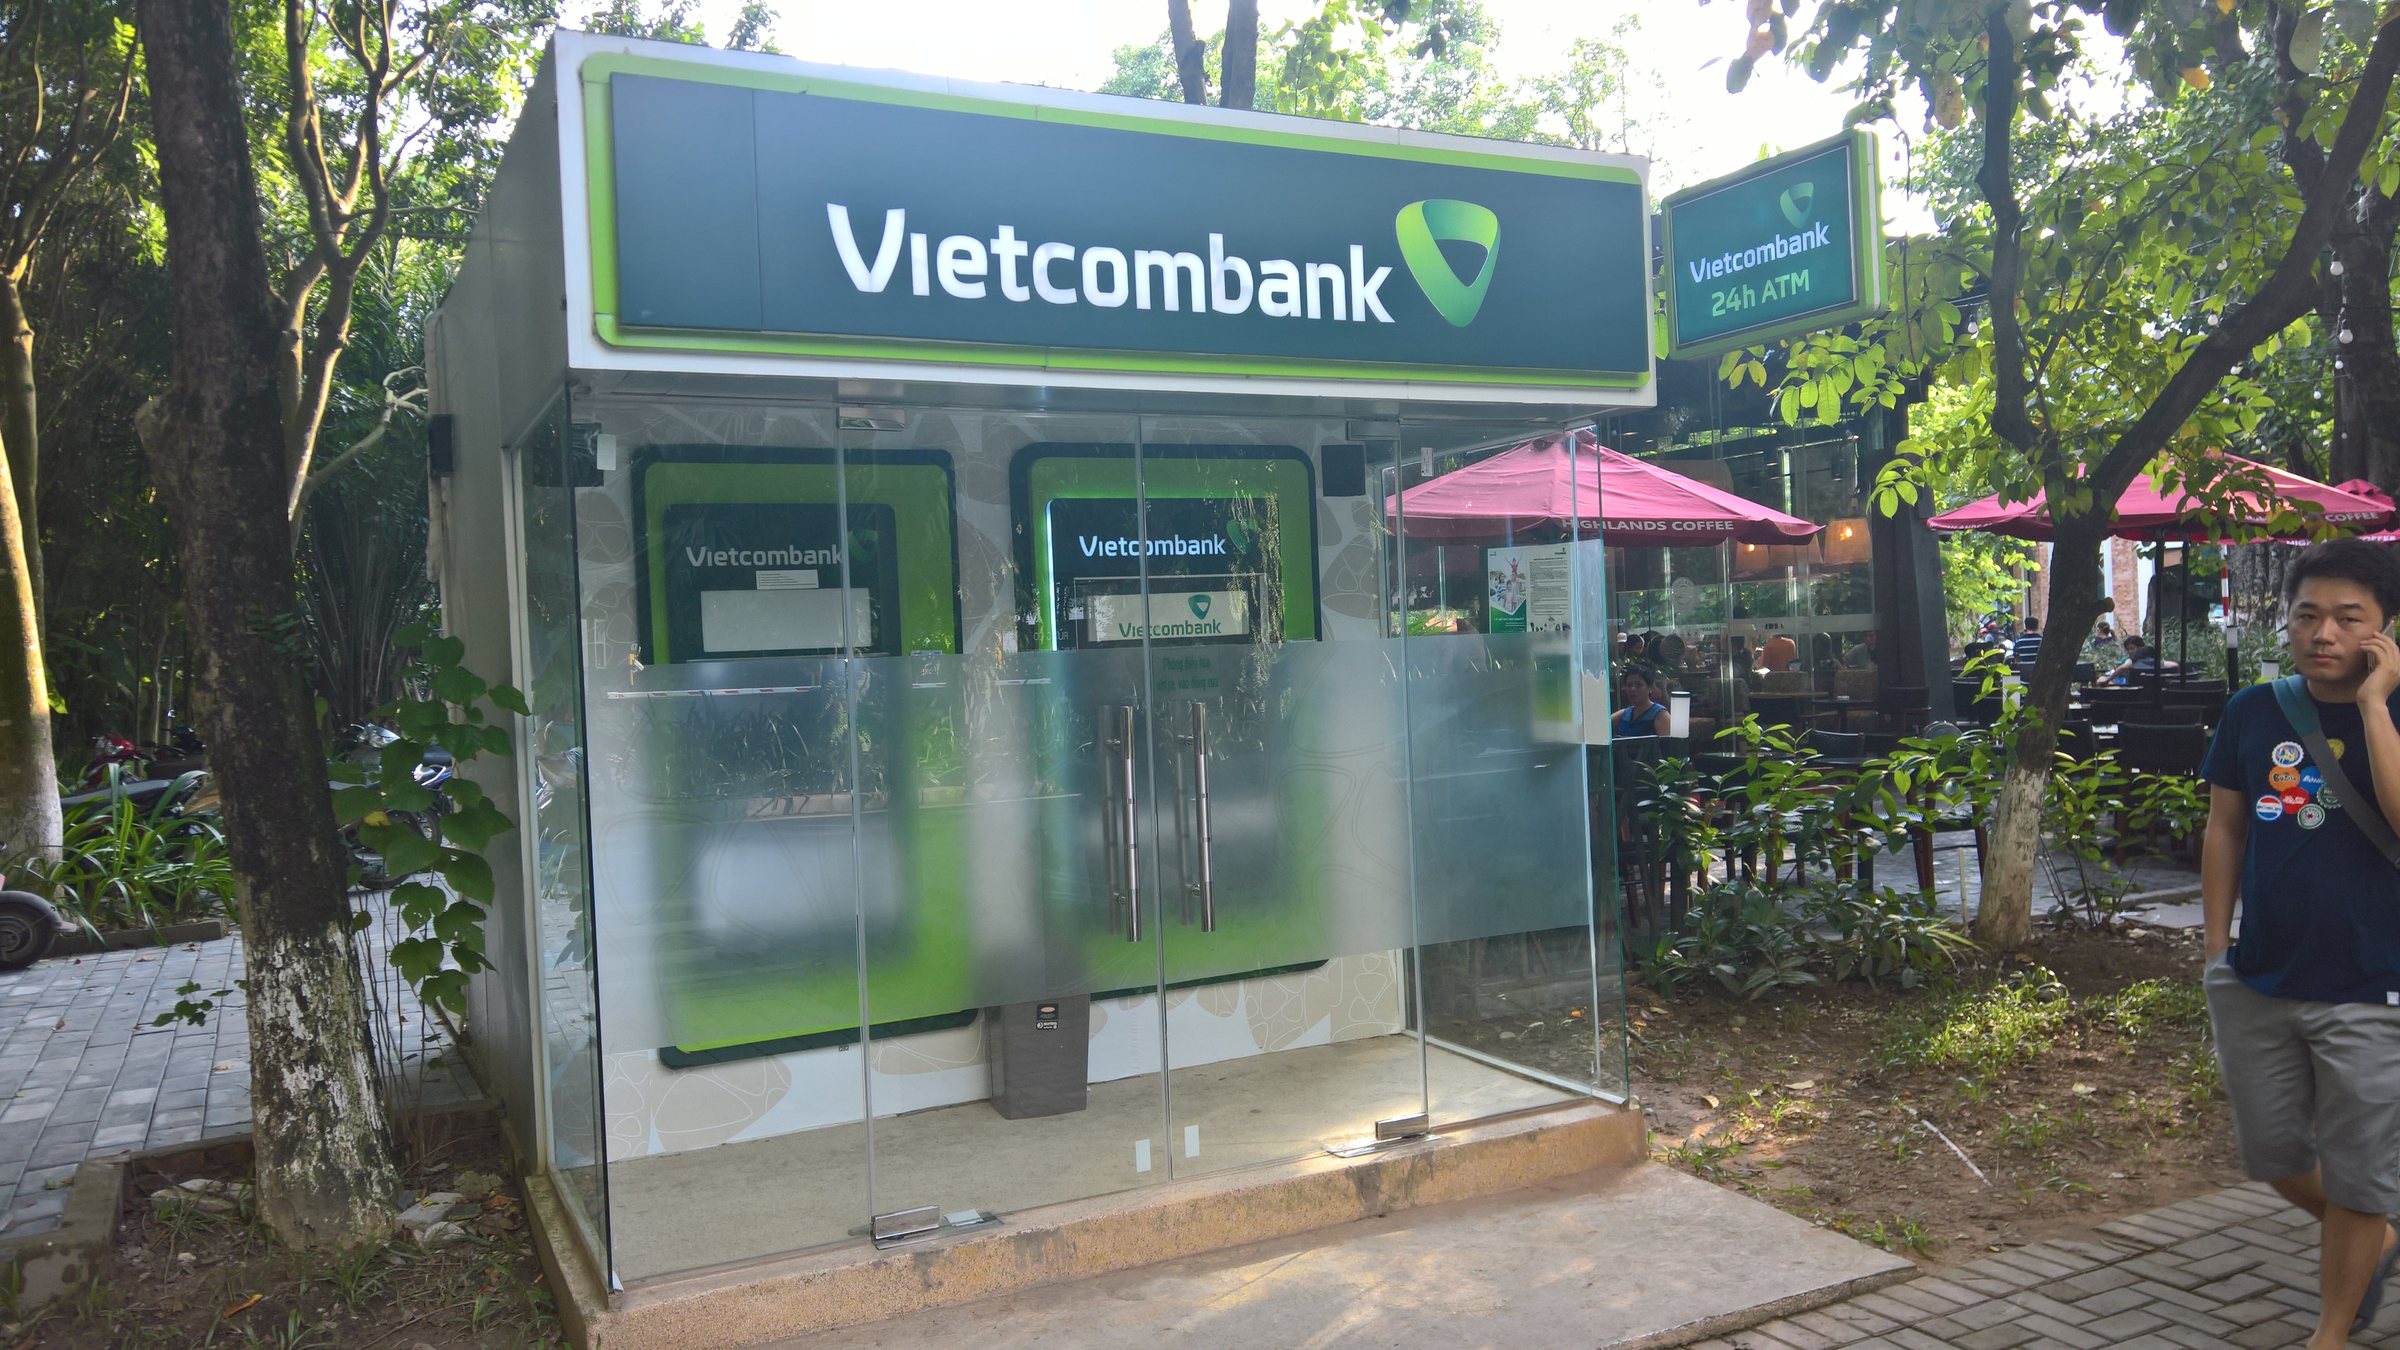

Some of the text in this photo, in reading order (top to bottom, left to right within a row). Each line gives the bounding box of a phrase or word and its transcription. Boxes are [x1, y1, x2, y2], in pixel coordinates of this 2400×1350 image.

[827, 203, 1396, 323] Vietcombank
[1689, 221, 1832, 284] Vietcombank
[1711, 268, 1811, 317] 24h ATM
[1671, 520, 1734, 532] COFFEE
[2324, 511, 2380, 523] COFFEE
[686, 544, 844, 568] Vietcombank
[1078, 533, 1227, 557] Vietcombank
[1118, 619, 1222, 638] Viecombank
